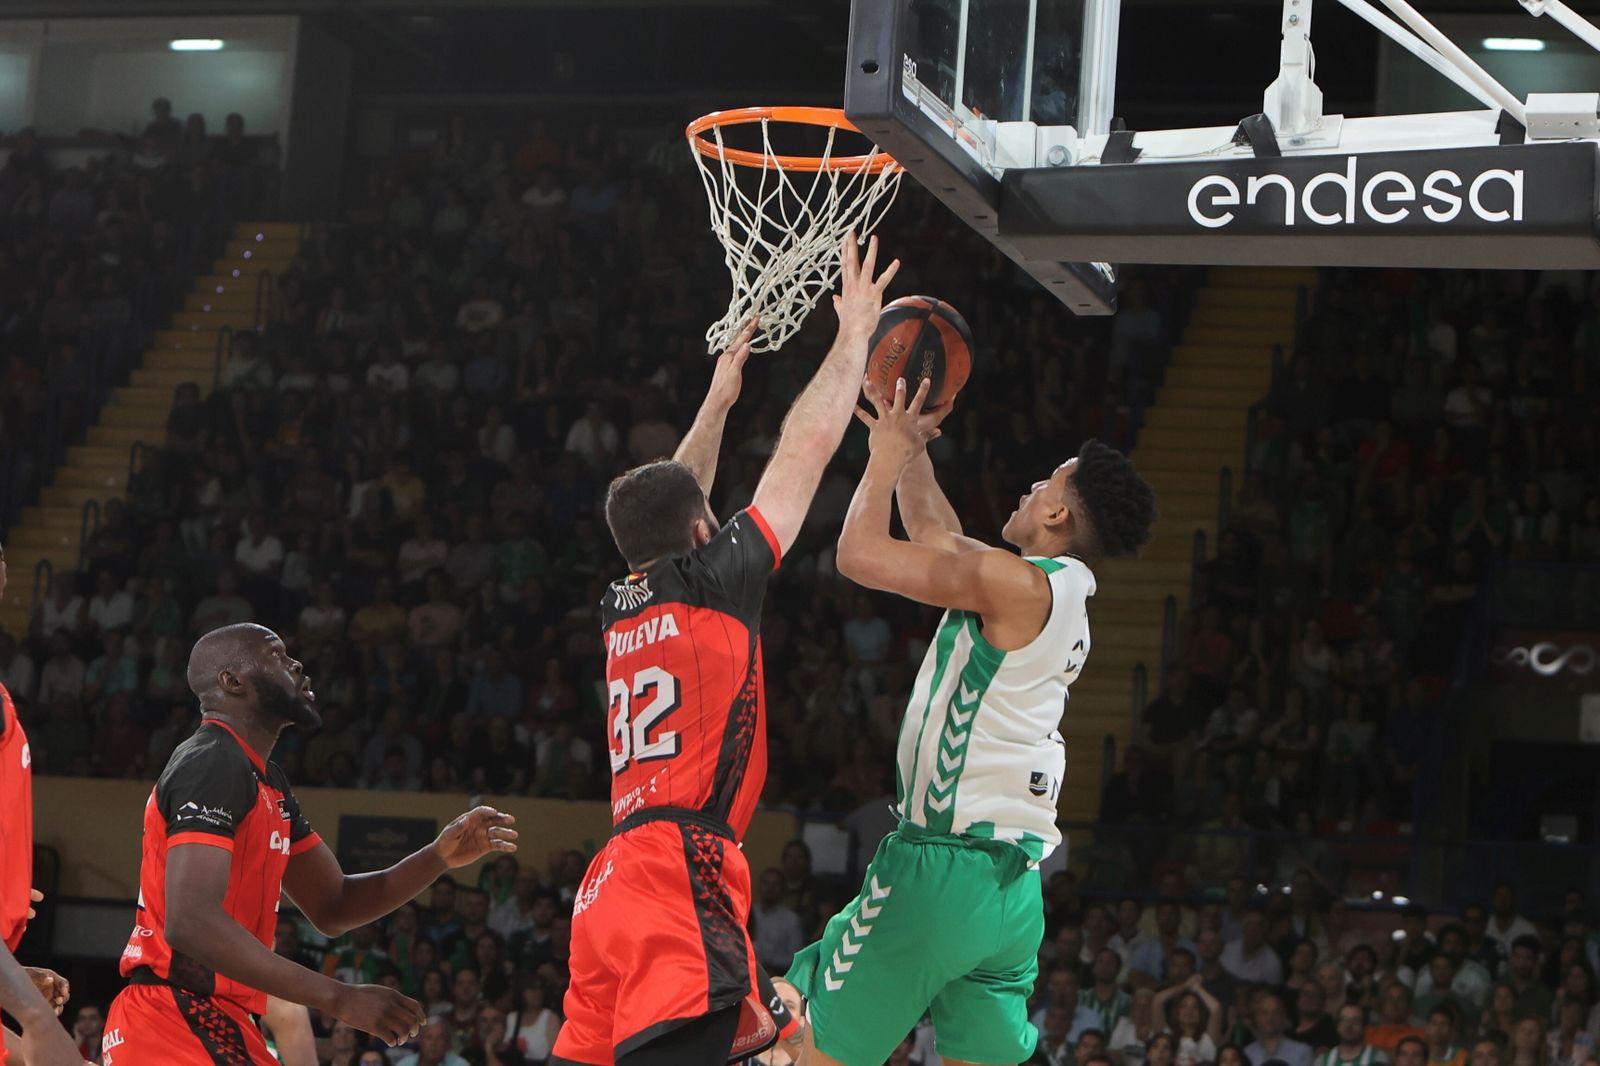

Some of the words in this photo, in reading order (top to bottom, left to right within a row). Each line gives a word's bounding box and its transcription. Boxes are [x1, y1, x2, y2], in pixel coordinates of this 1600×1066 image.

[1187, 156, 1524, 228] endesa
[608, 613, 680, 660] PULEVA
[609, 666, 682, 776] 32
